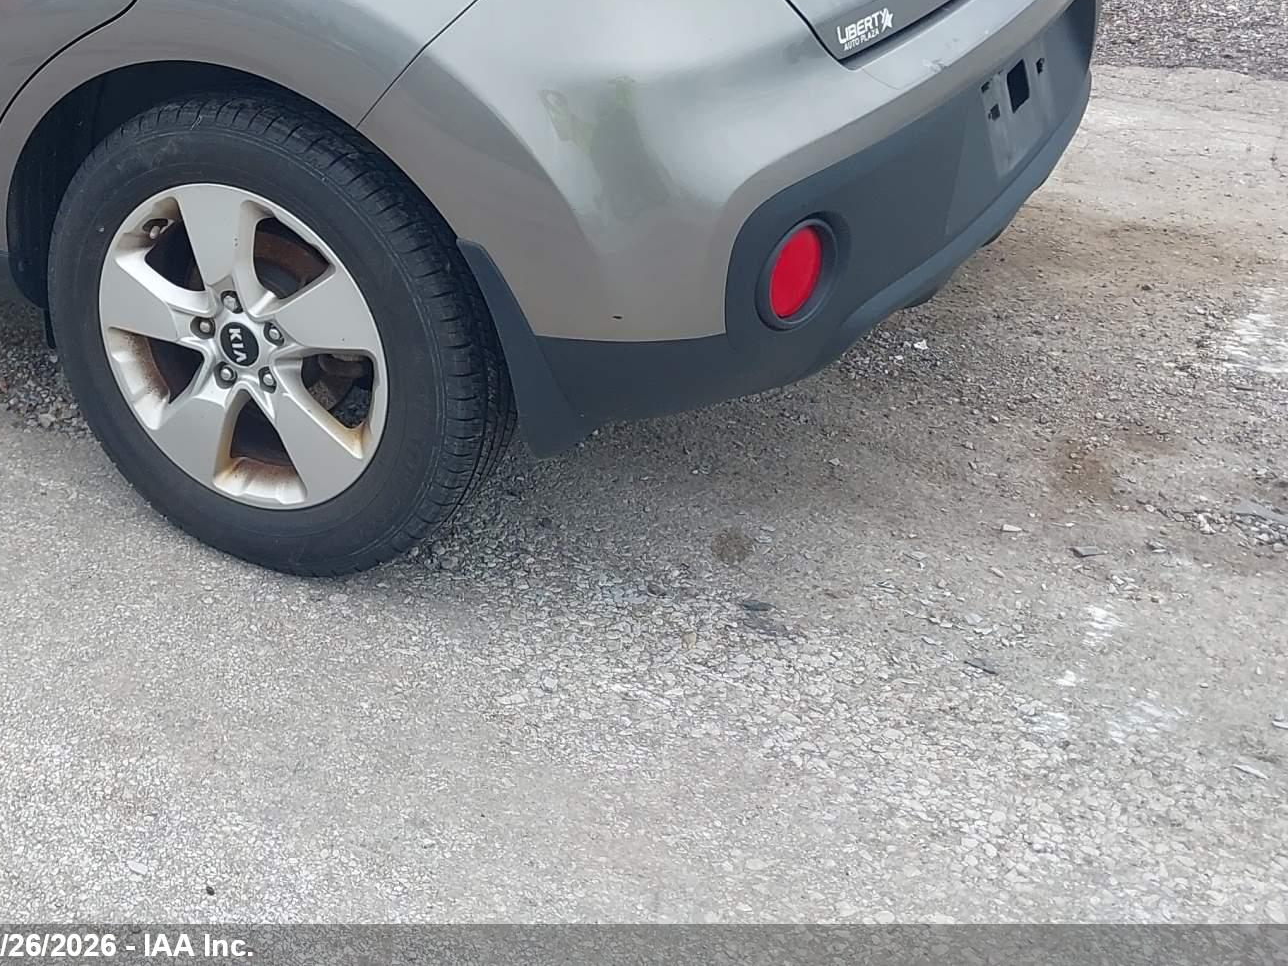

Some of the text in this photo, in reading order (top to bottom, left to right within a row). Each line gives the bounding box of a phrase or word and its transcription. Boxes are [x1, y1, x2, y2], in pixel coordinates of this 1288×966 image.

[837, 10, 886, 44] LIBERTY
[844, 28, 880, 51] AUTO PLAZA
[228, 328, 247, 363] KIA
